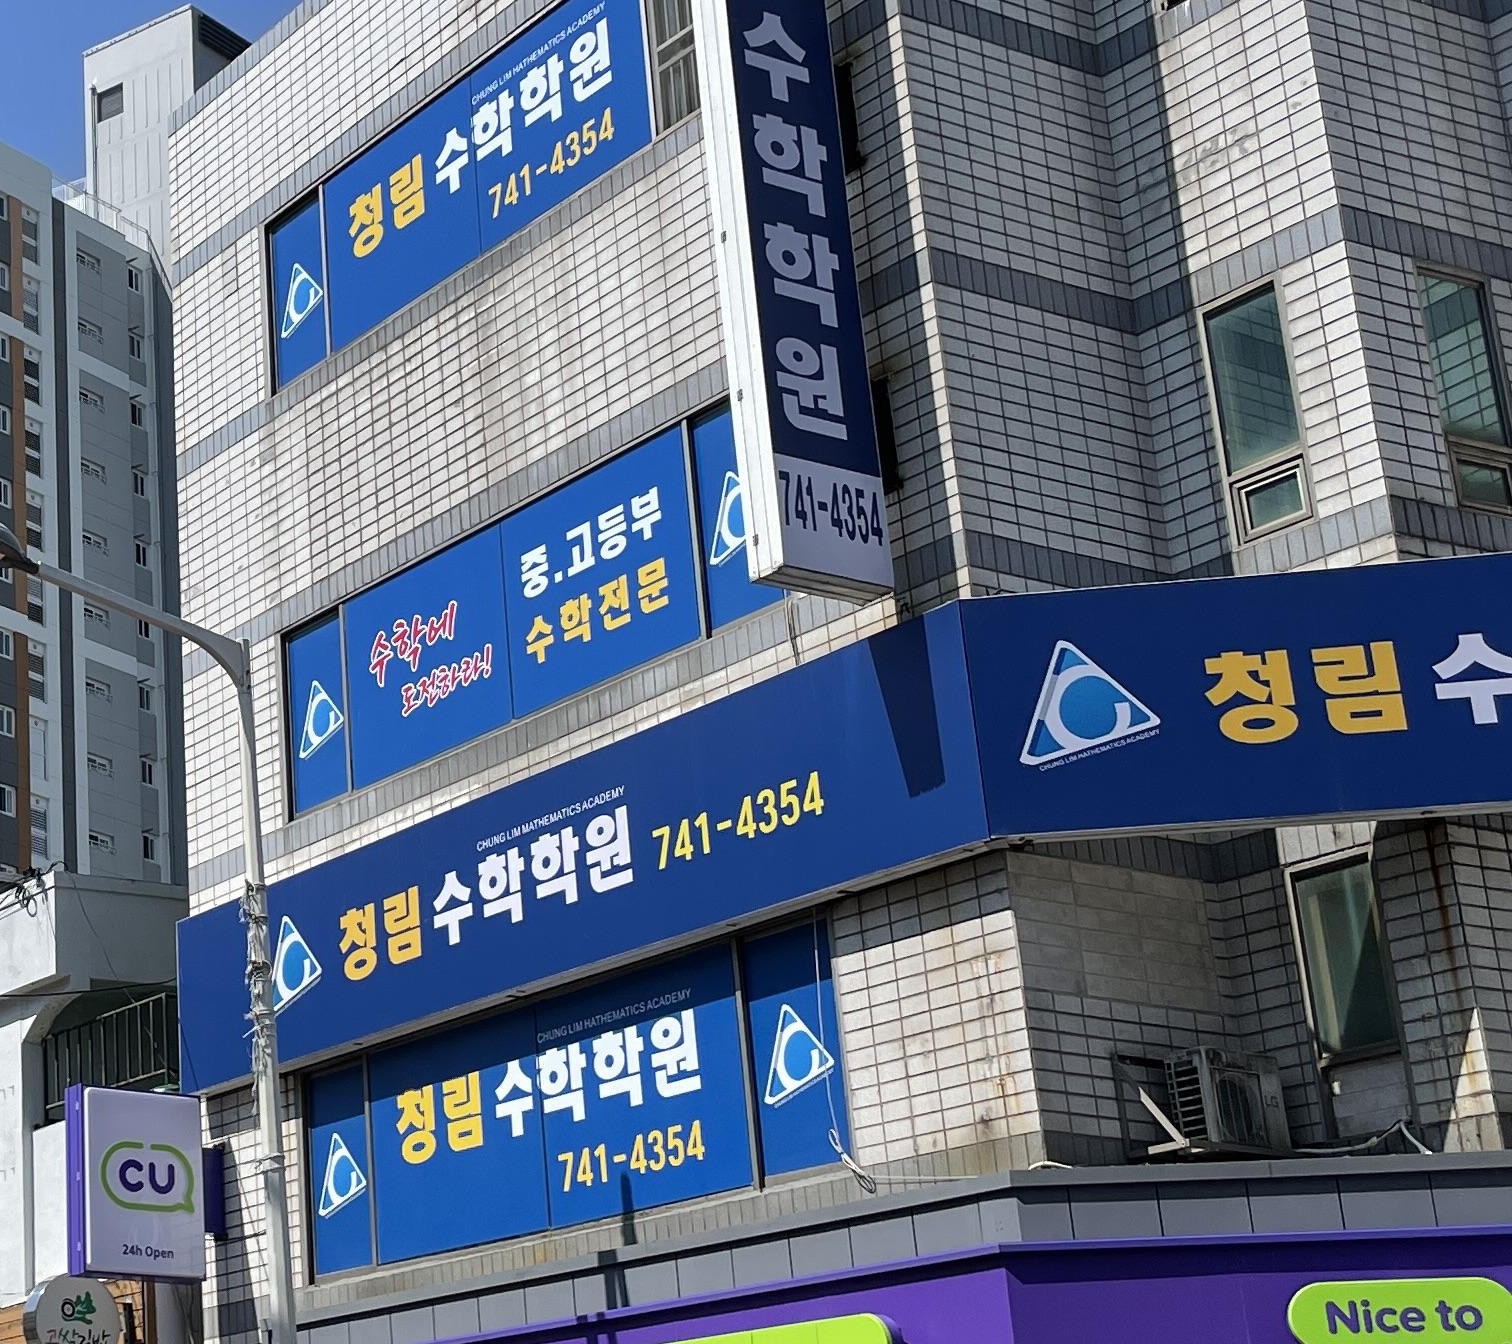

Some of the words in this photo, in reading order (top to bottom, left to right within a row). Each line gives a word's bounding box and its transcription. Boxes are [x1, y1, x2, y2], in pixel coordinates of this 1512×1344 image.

[472, 80, 498, 105] CHUNG
[499, 70, 512, 85] LIM
[567, 1, 606, 36] ACADEMY
[349, 154, 426, 258] 청림
[435, 17, 613, 195] 수학학원
[488, 107, 615, 219] 741-4354
[742, 11, 849, 443] 수학학원
[778, 466, 884, 549] 741-4354
[369, 600, 457, 687] 수학에
[401, 644, 493, 717] 도전하라!
[1203, 640, 1409, 745] 청림
[1039, 759, 1065, 771] CHUNG
[1126, 728, 1159, 744] ACADEMY
[476, 832, 506, 852] CHUNG
[506, 825, 521, 840] LIM
[522, 803, 582, 833] MATHEMATICS
[582, 785, 625, 811] ACADEMY
[338, 886, 423, 981] 청림
[432, 803, 634, 947] 수학학원
[652, 770, 825, 871] 741-4354
[537, 1026, 567, 1044] CHUNG
[568, 1021, 583, 1035] LIM
[646, 988, 691, 1009] ACADEMY
[396, 1071, 483, 1164] 청림
[494, 1009, 702, 1138] 수학학원
[118, 1158, 176, 1195] CU
[557, 1118, 706, 1193] 741-4354
[122, 1244, 142, 1257] 24h
[144, 1246, 175, 1261] Open
[1325, 1300, 1426, 1335] Nice
[1434, 1300, 1483, 1332] to
